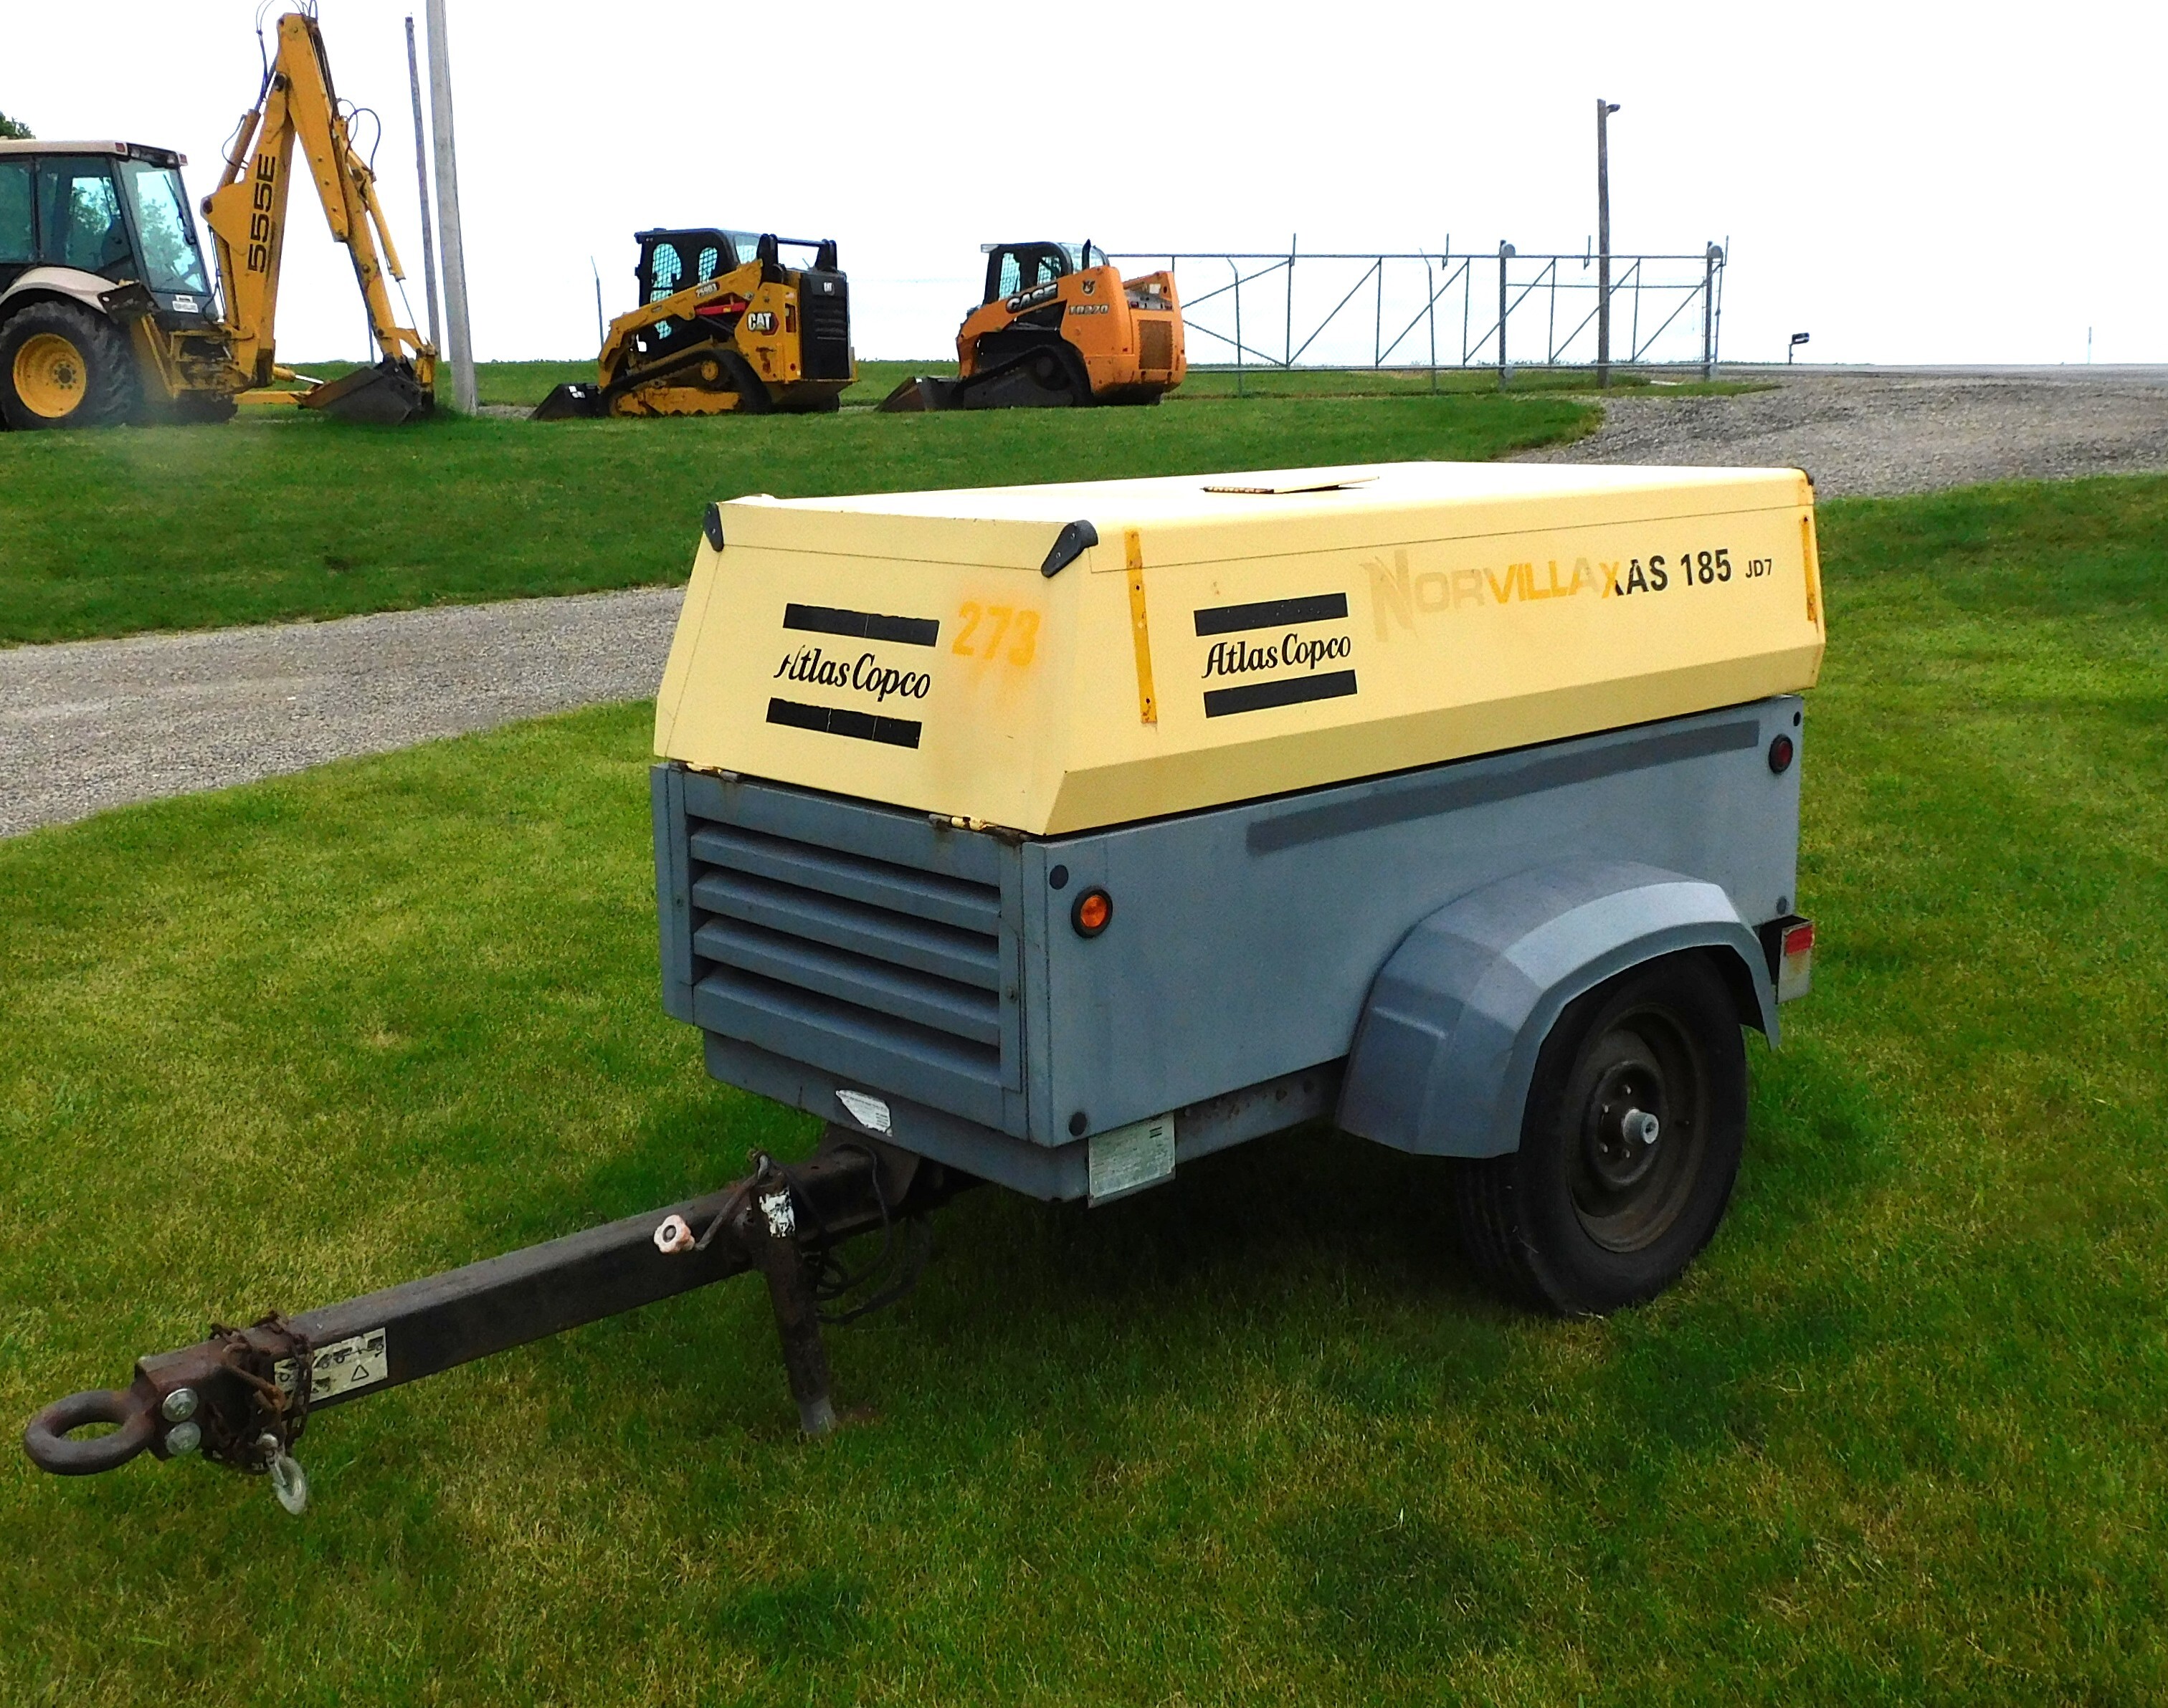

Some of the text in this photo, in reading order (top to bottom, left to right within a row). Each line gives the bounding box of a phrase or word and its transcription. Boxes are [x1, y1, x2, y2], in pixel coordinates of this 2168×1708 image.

[247, 153, 276, 273] 555E
[1007, 283, 1057, 311] CASE
[748, 313, 771, 331] CAT
[1680, 548, 1732, 586] 185
[1745, 558, 1772, 578] JD7
[951, 600, 1041, 667] 273
[1201, 633, 1351, 679] Atlas Copco
[773, 644, 931, 702] Atlas Copco
